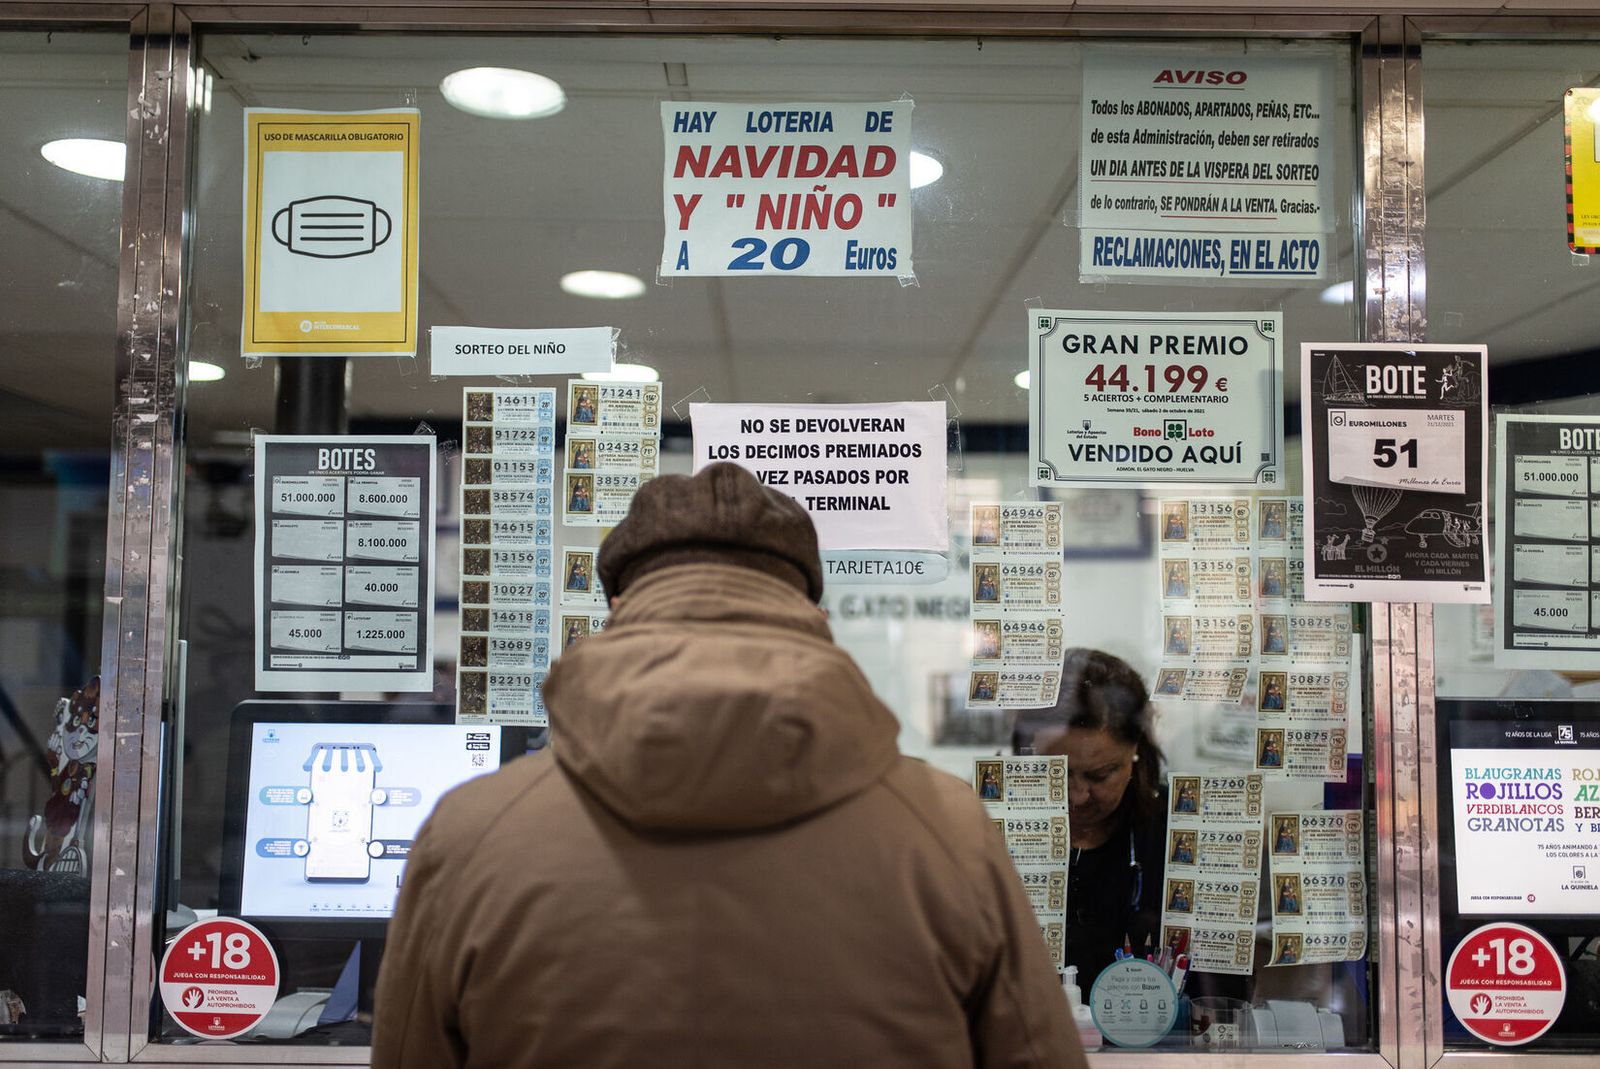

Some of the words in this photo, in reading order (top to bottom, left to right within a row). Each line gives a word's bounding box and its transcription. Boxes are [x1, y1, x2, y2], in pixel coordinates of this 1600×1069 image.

[1154, 70, 1247, 85] AVISO
[1091, 99, 1118, 115] Todos
[1121, 101, 1134, 116] los
[1137, 101, 1192, 120] ABONADOS,
[1194, 103, 1253, 121] APARTADOS,
[1256, 100, 1290, 121] PEÑAS,
[1293, 104, 1320, 119] ETC...
[673, 111, 717, 132] HAY
[746, 111, 833, 132] LOTERIA
[865, 111, 893, 132] DE
[265, 133, 282, 141] USO
[283, 133, 293, 141] DE
[295, 133, 346, 141] MASCARILLA
[348, 133, 404, 141] OBLIGATORIO
[1091, 128, 1103, 143] de
[1107, 129, 1130, 144] esta
[1133, 129, 1214, 148] Administración,
[1218, 130, 1249, 146] deben
[1253, 135, 1270, 146] ser
[1272, 132, 1319, 148] retirados
[673, 145, 896, 178] NAVIDAD
[1091, 160, 1106, 176] UN
[1109, 160, 1128, 176] DIA
[1130, 160, 1166, 177] ANTES
[1170, 161, 1184, 178] DE
[1187, 161, 1200, 178] LA
[1204, 161, 1249, 179] VISPERA
[1253, 163, 1272, 180] DEL
[1276, 163, 1319, 181] SORTEO
[673, 194, 703, 230] Y
[756, 184, 863, 230] NIÑO
[1091, 194, 1101, 209] de
[1104, 194, 1112, 209] lo
[1115, 195, 1158, 213] contrario,
[1161, 196, 1172, 210] SE
[1174, 193, 1218, 212] PONDRÁN
[1221, 197, 1228, 212] A
[1231, 198, 1242, 212] LA
[1245, 198, 1277, 213] VENTA.
[1280, 199, 1320, 214] Gracias.-
[676, 240, 690, 270] A
[726, 237, 811, 270] 20
[845, 239, 897, 270] Euros
[1093, 236, 1225, 276] RECLAMACIONES,
[1230, 239, 1250, 270] EN
[1255, 239, 1274, 270] EL
[1278, 239, 1319, 270] ACTO
[455, 344, 504, 354] SORTEO
[508, 344, 530, 355] DEL
[534, 341, 566, 354] NIÑO
[1062, 334, 1139, 354] GRAN
[1150, 335, 1248, 355] PREMIO
[1085, 364, 1208, 393] 44.199
[1215, 377, 1228, 392] €
[1366, 365, 1427, 394] BOTE
[601, 388, 640, 397] 71241
[498, 396, 535, 404] 14611
[1084, 393, 1089, 402] 5
[1092, 393, 1134, 402] ACIERTOS
[1144, 394, 1228, 404] COMPLEMENTARIO
[741, 419, 764, 433] NO
[769, 419, 790, 433] SE
[796, 418, 905, 432] DEVOLVERAN
[496, 430, 535, 439] 91722
[1133, 427, 1162, 437] Bono
[1189, 427, 1214, 437] Loto
[598, 442, 638, 451] 02432
[708, 445, 740, 460] LOS
[746, 444, 819, 459] DECIMOS
[826, 443, 922, 458] PREMIADOS
[1068, 443, 1173, 462] VENDIDO
[1182, 441, 1243, 464] AQUÍ
[1373, 438, 1418, 468] 51
[319, 448, 376, 470] BOTES
[494, 462, 534, 471] 01153
[597, 476, 637, 484] 38574
[756, 470, 788, 485] VEZ
[794, 470, 870, 484] PASADOS
[875, 469, 909, 484] POR
[1524, 472, 1578, 481] 51.000.000
[281, 493, 336, 502] 51.000.000
[359, 494, 407, 503] 8.600.000
[494, 492, 534, 500] 38574
[806, 496, 890, 511] TERMINAL
[1192, 504, 1232, 512] 13156
[1003, 508, 1043, 517] 64946
[494, 523, 533, 531] 14615
[358, 538, 406, 547] 8.100.000
[494, 553, 534, 561] 13156
[826, 560, 924, 575] TARJETA10€
[1003, 566, 1043, 574] 64946
[1193, 561, 1233, 569] 13156
[365, 582, 398, 592] 40.000
[494, 585, 533, 594] 10027
[493, 612, 532, 620] 14618
[1534, 607, 1568, 617] 45.000
[1004, 623, 1044, 631] 64946
[1196, 619, 1235, 627] 13156
[1291, 618, 1331, 626] 50875
[289, 628, 322, 638] 45.000
[357, 629, 405, 639] 1.225.000
[492, 641, 531, 649] 13689
[490, 676, 530, 684] 82210
[1290, 675, 1330, 683] 50875
[1287, 732, 1328, 740] 50875
[1560, 727, 1571, 739] 75
[1007, 763, 1047, 772] 96532
[1465, 767, 1562, 780] BLAUGRANAS
[1204, 779, 1244, 788] 75760
[1466, 782, 1563, 800] ROJILLOS
[1467, 804, 1563, 815] VERDIBLANCOS
[1008, 822, 1048, 830] 96532
[1302, 817, 1343, 826] 66370
[1468, 817, 1564, 832] GRANOTAS
[1202, 833, 1242, 841] 75760
[1304, 876, 1344, 885] 66370
[1198, 883, 1239, 892] 75760
[1194, 931, 1234, 940] 75760
[1306, 936, 1346, 944] 66370
[187, 932, 250, 970] +18
[1472, 938, 1535, 976] +18
